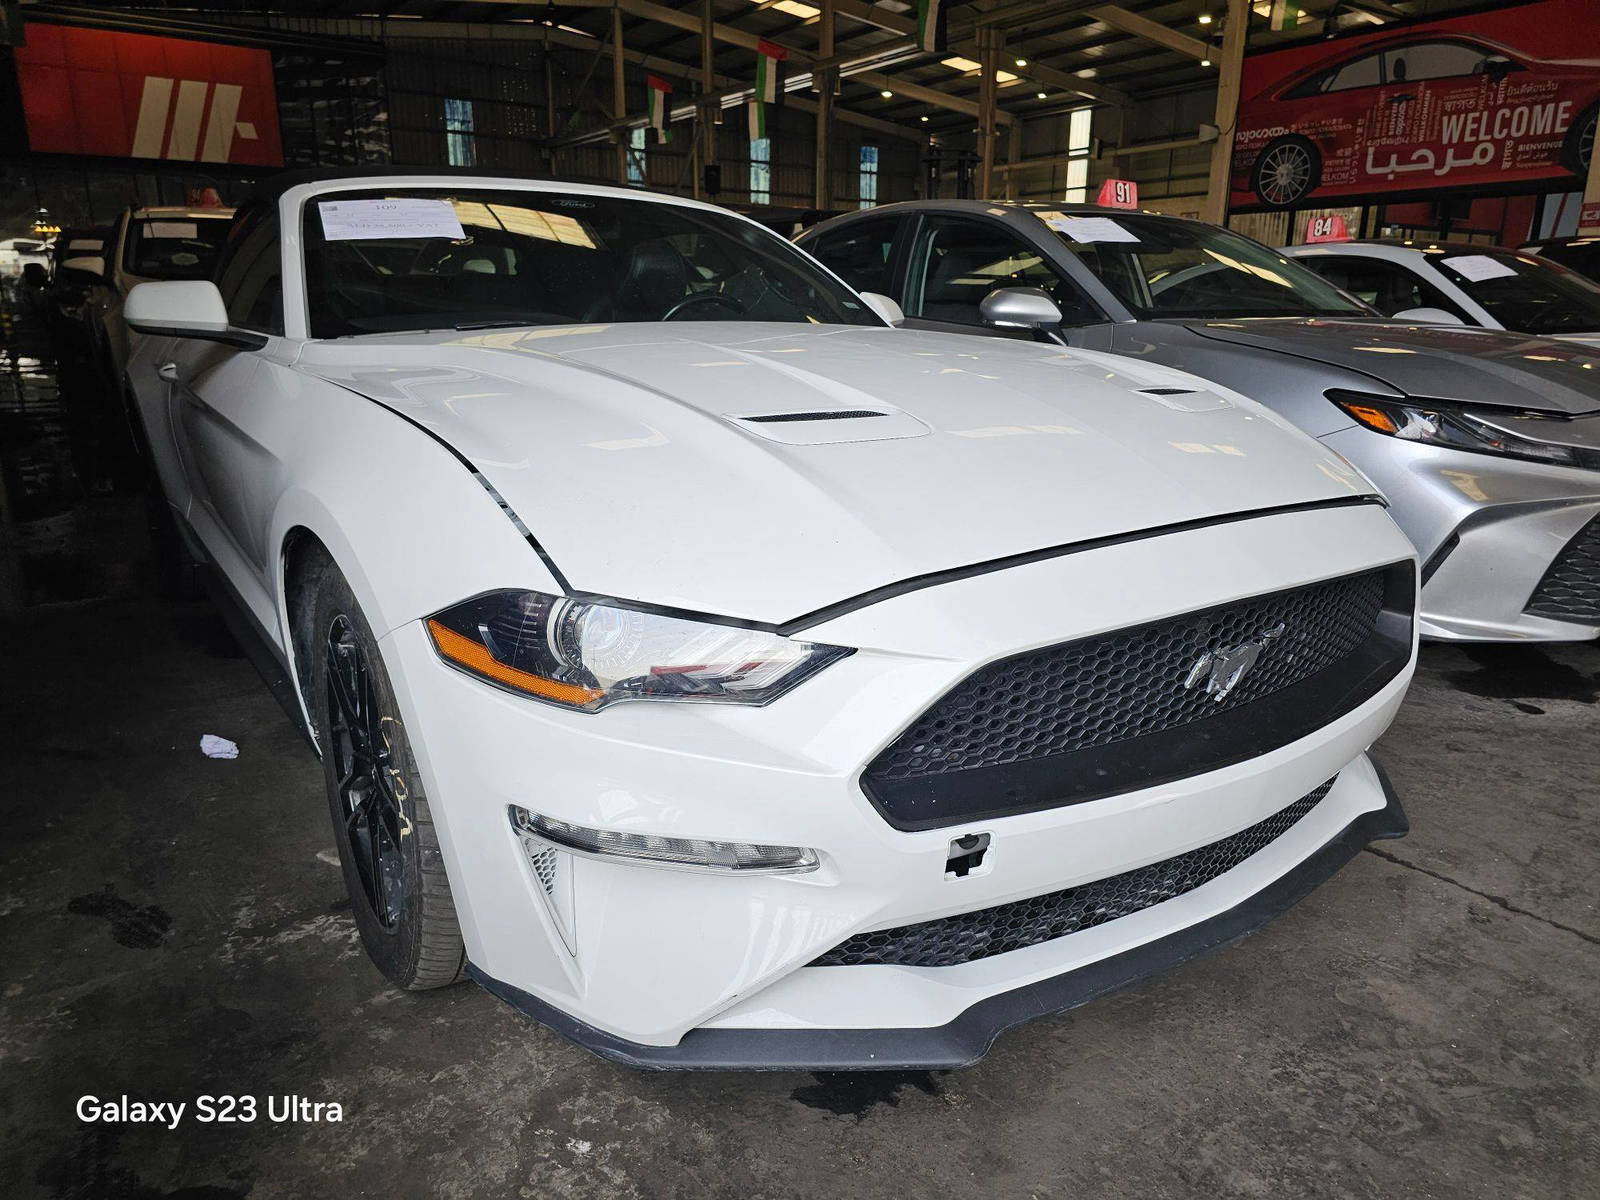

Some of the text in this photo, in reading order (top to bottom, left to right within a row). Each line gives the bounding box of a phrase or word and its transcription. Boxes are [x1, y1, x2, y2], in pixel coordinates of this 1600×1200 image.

[1442, 100, 1573, 144] WELCOME
[1518, 141, 1563, 152] BIENVENUE
[1365, 143, 1494, 179] مرحبا
[1116, 182, 1130, 203] 91
[1314, 217, 1332, 236] 84
